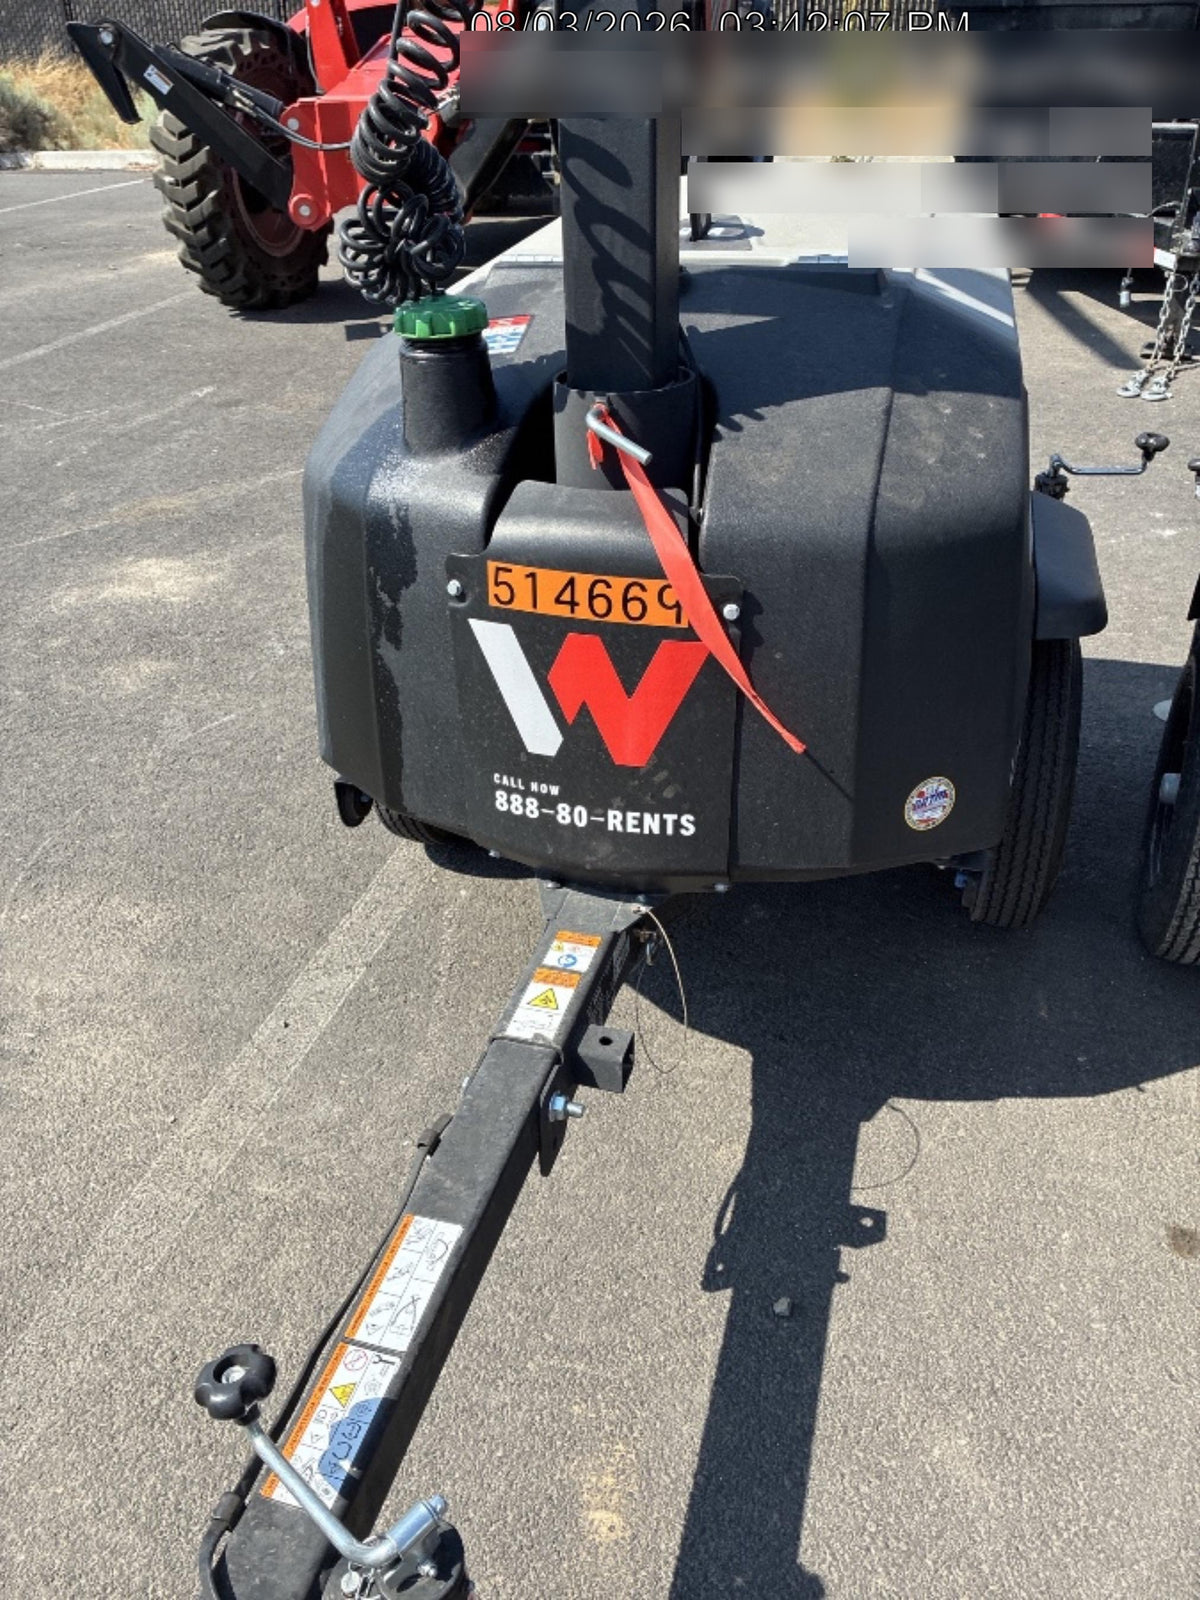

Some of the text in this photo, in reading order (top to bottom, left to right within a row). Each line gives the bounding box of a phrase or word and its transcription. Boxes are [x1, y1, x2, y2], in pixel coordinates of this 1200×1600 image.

[493, 566, 683, 625] 514669
[493, 773, 560, 796] CALL NOW
[494, 790, 696, 836] 888-80-RENTS
